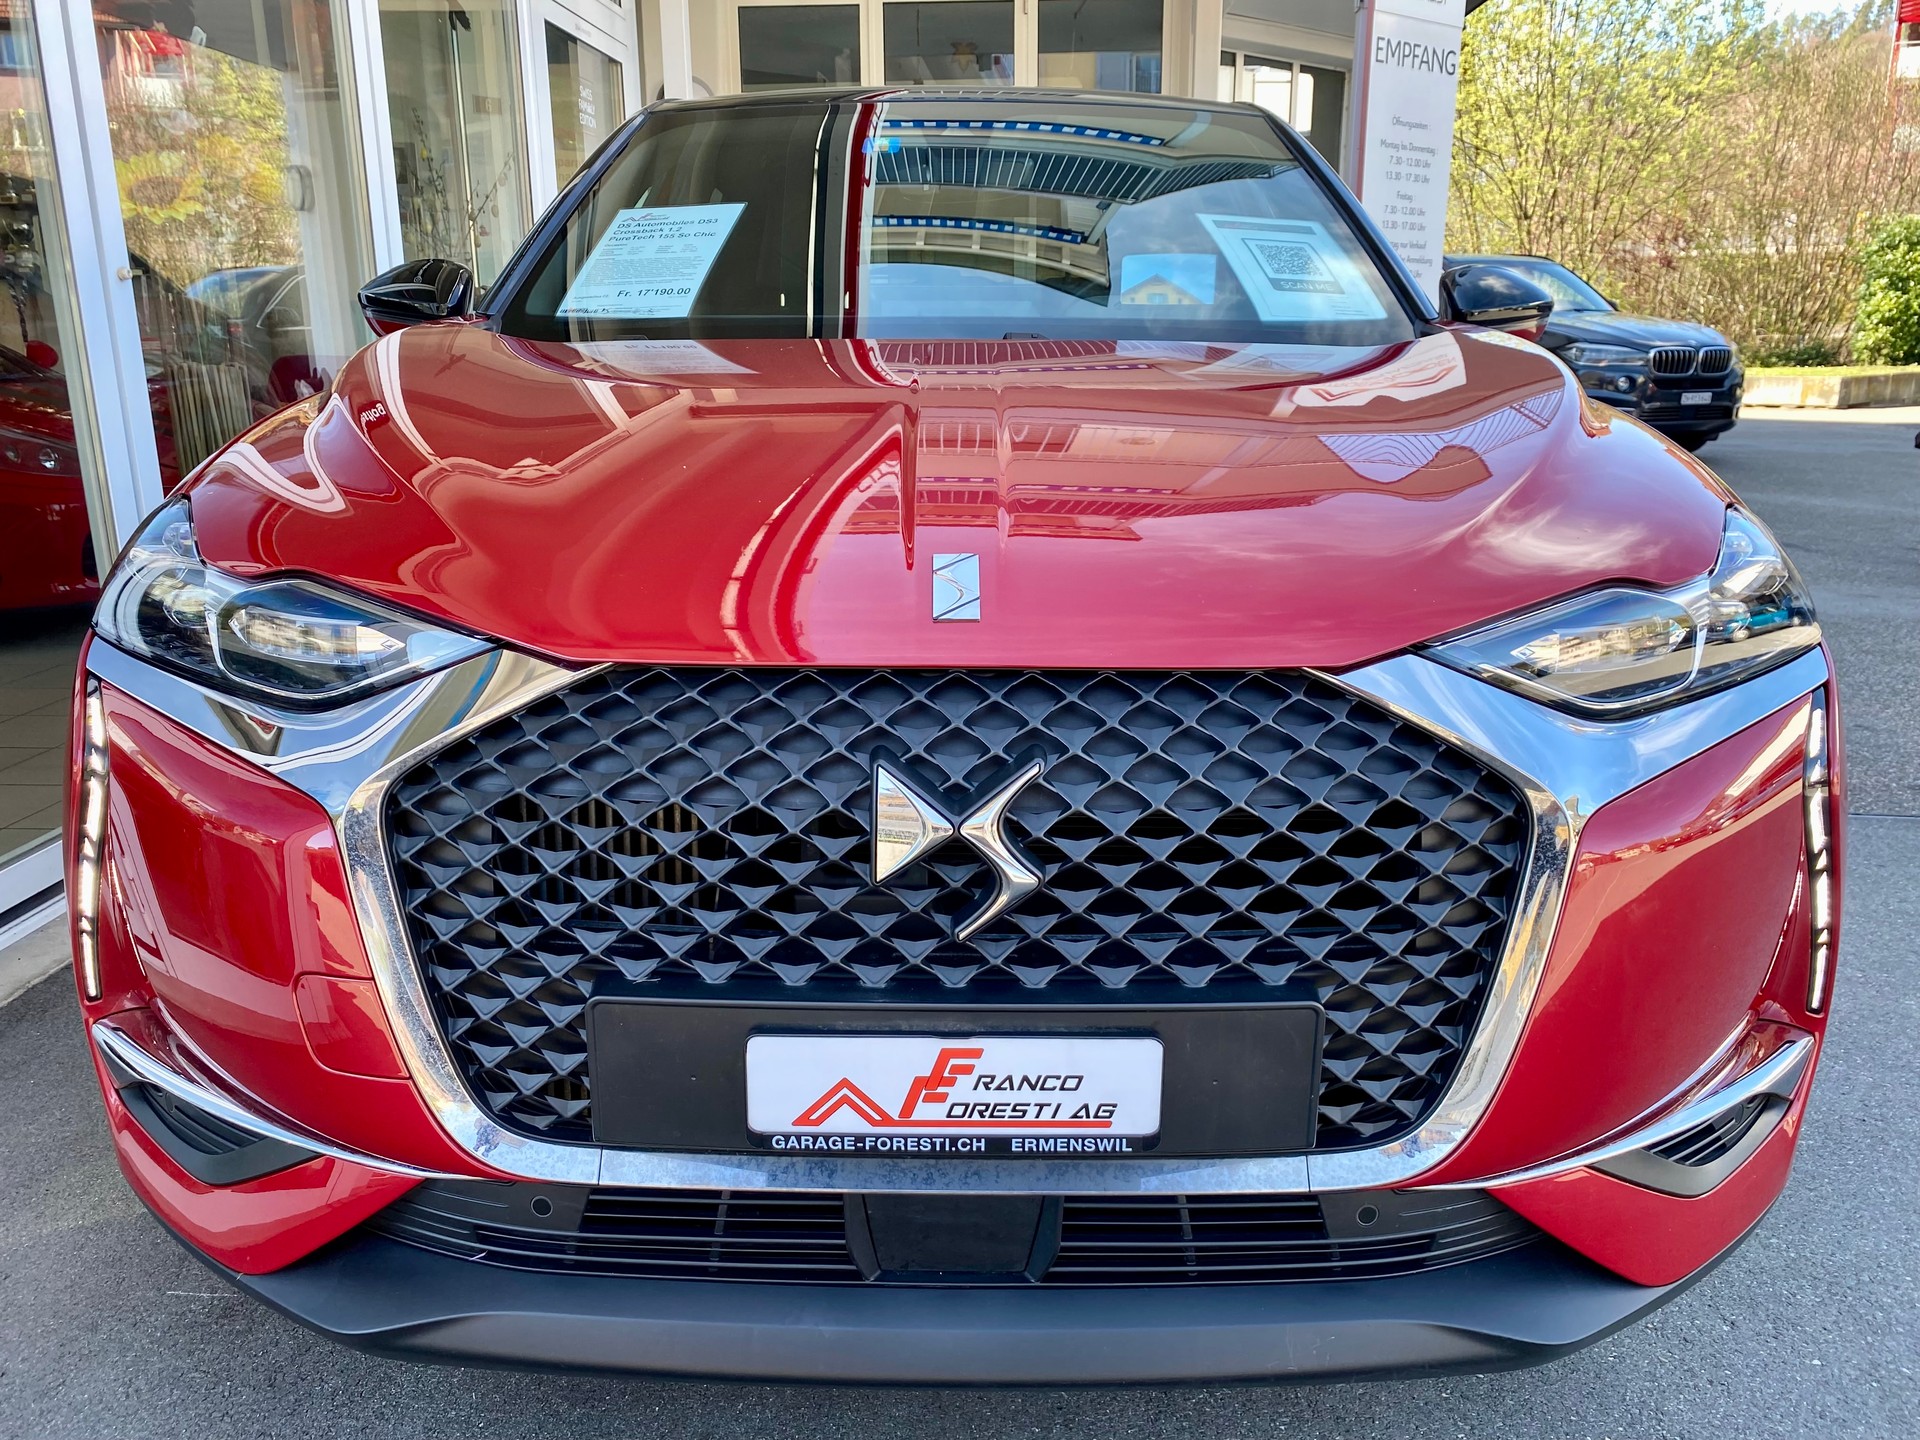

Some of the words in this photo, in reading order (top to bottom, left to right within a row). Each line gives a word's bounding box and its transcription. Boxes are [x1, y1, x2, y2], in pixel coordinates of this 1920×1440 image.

[1375, 36, 1457, 76] EMPFANG
[579, 112, 597, 129] EDITION
[633, 220, 695, 228] Automobiles
[613, 227, 664, 235] Crossback
[608, 234, 655, 242] PureTech
[1280, 280, 1314, 291] SCAN
[1315, 282, 1334, 291] ME
[617, 289, 632, 298] Fr.
[637, 287, 691, 297] 17'190.00
[1068, 1103, 1118, 1119] AG
[771, 1135, 986, 1152] GARAGE-FORESTI.CH
[1011, 1138, 1133, 1152] ERMENSWIL
